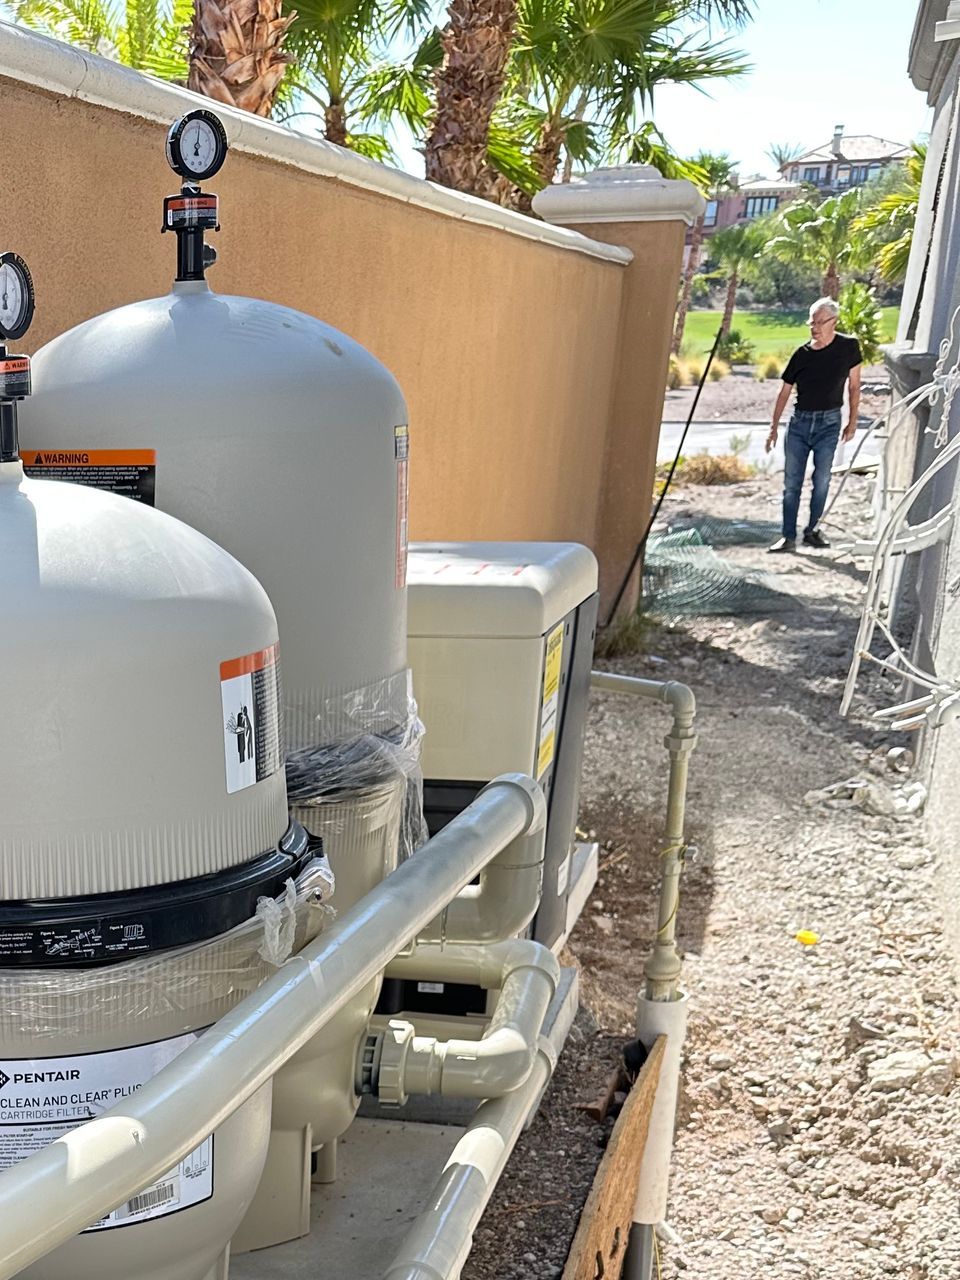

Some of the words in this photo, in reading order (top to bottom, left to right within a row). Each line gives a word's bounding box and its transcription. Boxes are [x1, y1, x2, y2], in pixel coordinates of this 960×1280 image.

[43, 453, 89, 464] WARNING
[13, 1069, 80, 1084] PENTAIR
[0, 1098, 40, 1109] CLEAN
[43, 1094, 68, 1107] AND
[0, 1109, 54, 1120] CARTRIDGE
[56, 1106, 90, 1117] FILTER
